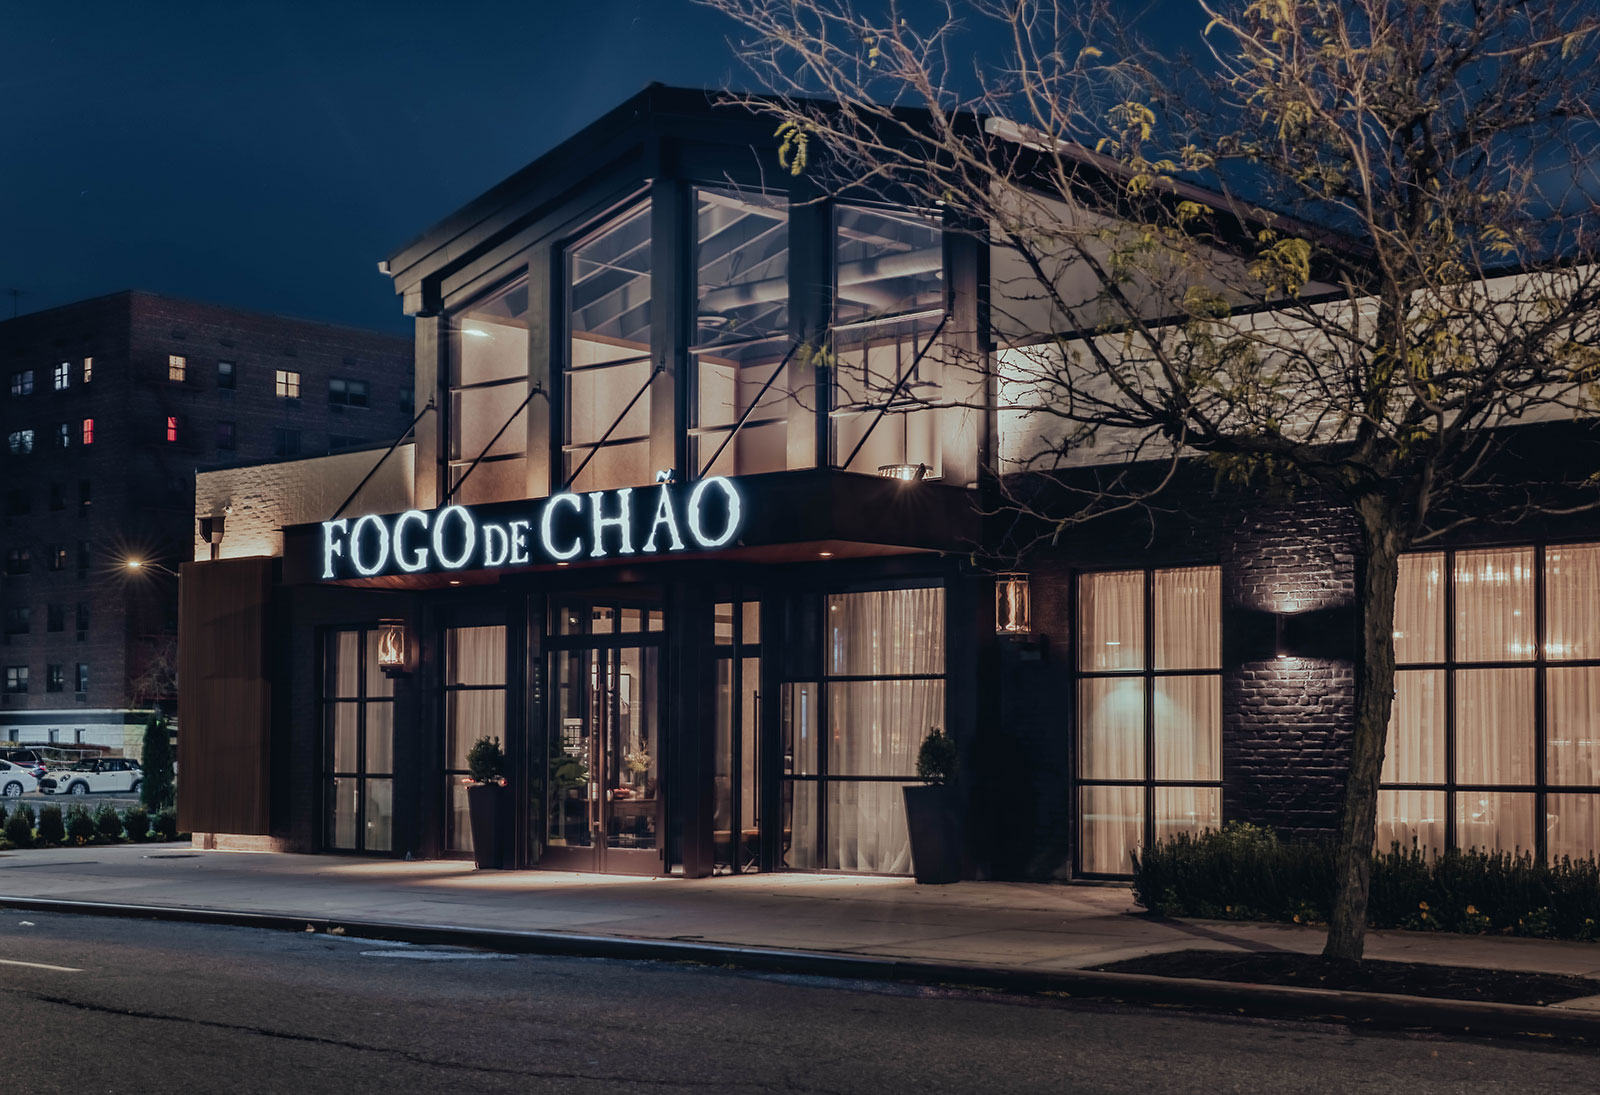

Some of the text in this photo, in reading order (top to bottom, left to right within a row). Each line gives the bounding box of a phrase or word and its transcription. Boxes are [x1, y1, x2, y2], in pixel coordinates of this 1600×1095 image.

[322, 468, 741, 579] FOGO DE CHÃO
